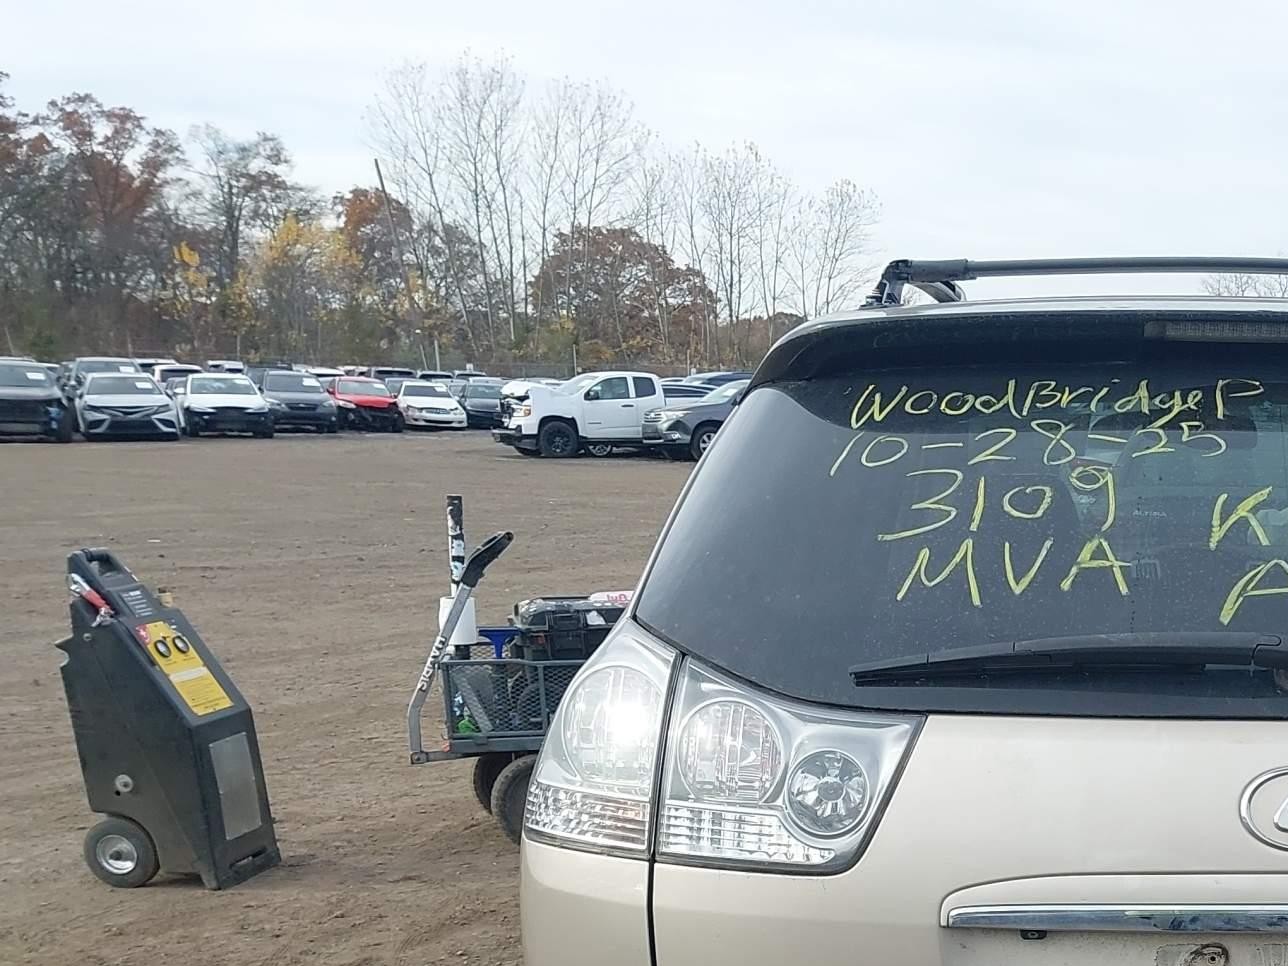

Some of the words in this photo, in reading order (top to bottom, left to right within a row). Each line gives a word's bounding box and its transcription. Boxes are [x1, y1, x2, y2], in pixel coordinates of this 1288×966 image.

[829, 418, 1227, 476] 10-28-25
[877, 465, 1116, 542] 3109
[896, 534, 1132, 607] MVA
